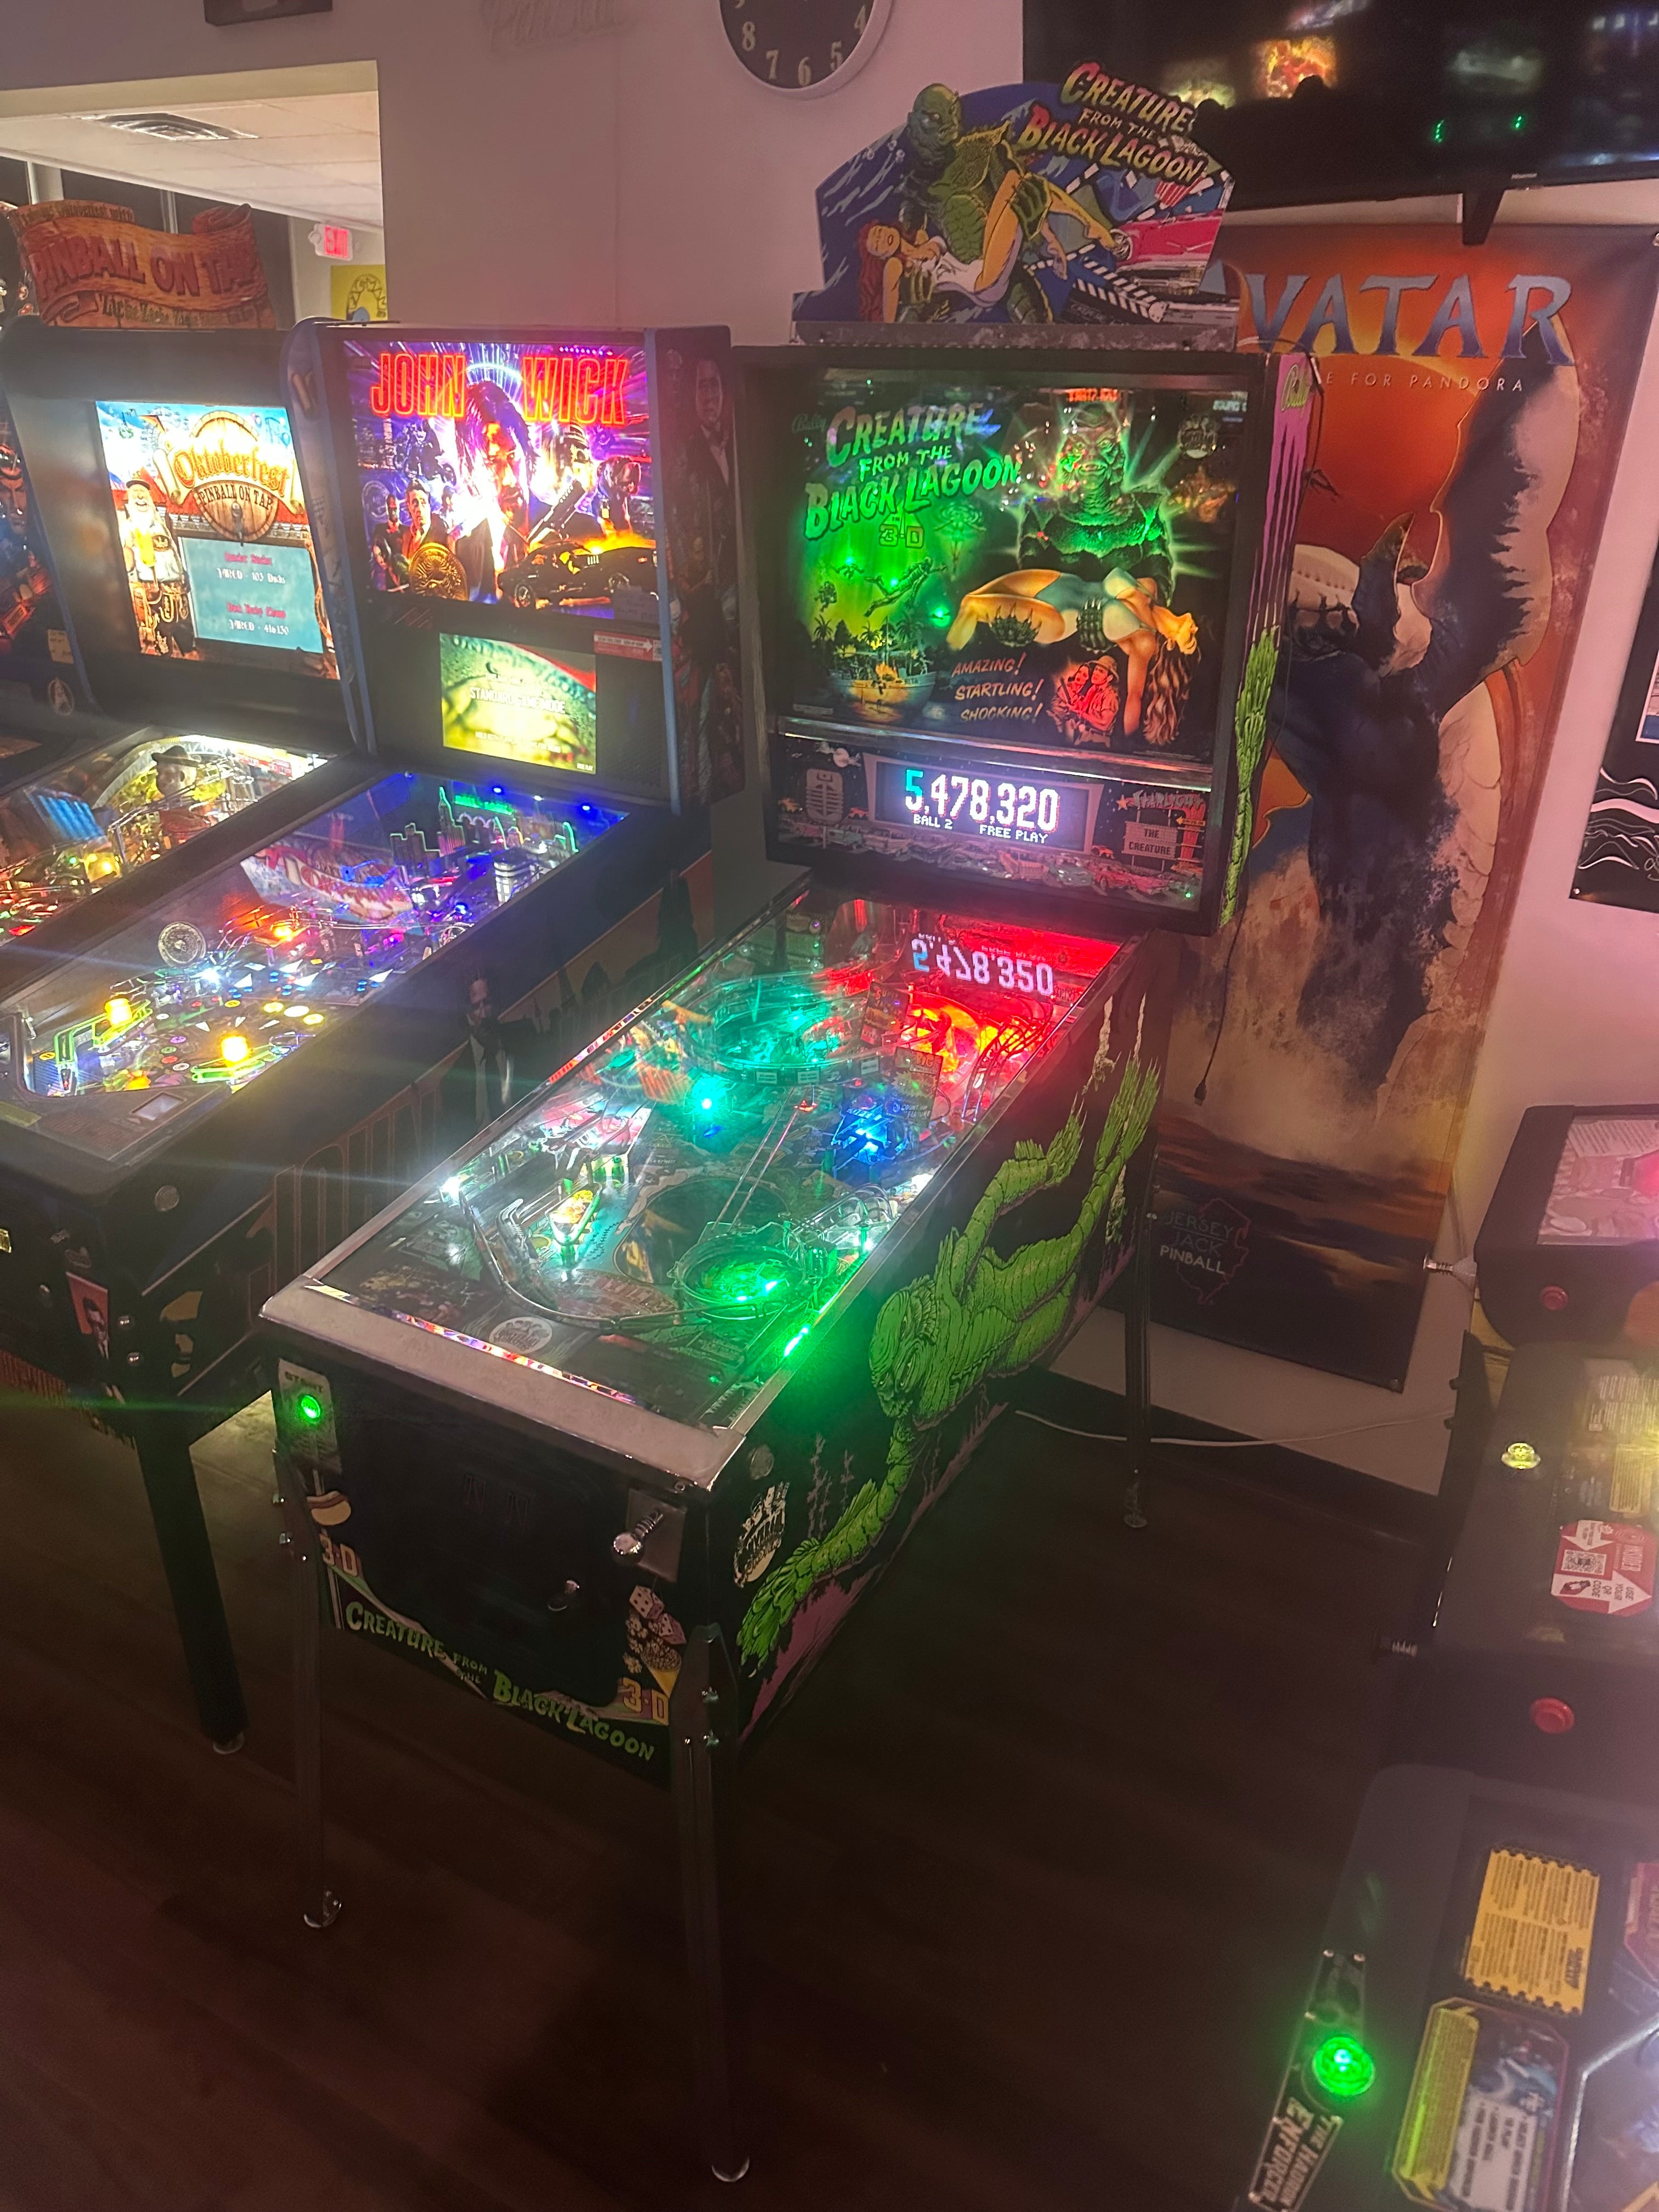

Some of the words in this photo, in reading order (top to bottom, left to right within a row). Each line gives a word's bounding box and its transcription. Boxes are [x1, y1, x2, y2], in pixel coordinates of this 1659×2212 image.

[742, 21, 756, 52] 8
[766, 49, 779, 80] 7
[798, 56, 811, 86] 6
[830, 41, 844, 72] 5
[1060, 61, 1194, 132] CREATURE
[1077, 108, 1123, 129] FROM
[1127, 122, 1156, 138] THE
[1012, 104, 1108, 160] BLACK
[1099, 132, 1205, 182] LAGOON
[30, 235, 146, 300] PINBALL
[150, 246, 201, 297] ON
[370, 352, 467, 419] JOHN
[521, 355, 629, 426] WICK
[1351, 373, 1392, 387] FOR
[1410, 375, 1524, 392] PANDORA
[826, 402, 986, 467] CREATURE
[173, 439, 290, 498] Oktoberfest
[859, 452, 909, 482] FROM
[916, 445, 952, 466] THE
[198, 483, 237, 506] PINBALL
[239, 485, 251, 501] ON
[253, 490, 275, 510] TAP
[804, 473, 900, 540] BLACK
[904, 455, 1022, 515] LAGOON
[879, 524, 925, 549] 3-D
[951, 651, 1027, 678] AMAZING!
[955, 679, 1044, 701] STARTLING!
[960, 703, 1043, 725] SHOCKING!
[905, 769, 1060, 833] 5,478,320
[913, 814, 941, 828] BALL
[944, 819, 953, 830] 2
[979, 825, 1011, 839] FREE
[1015, 830, 1048, 844] PLAY
[1144, 828, 1160, 839] THE
[1128, 842, 1172, 855] CREATURE
[1164, 1211, 1234, 1239] JERSEY
[1160, 1245, 1226, 1274] PINBALL
[1170, 1232, 1223, 1257] JACK
[319, 1533, 360, 1577] 3-D
[1592, 1580, 1602, 1598] CODE
[1602, 1585, 1612, 1595] QR
[1613, 1583, 1624, 1601] YOUR
[1625, 1587, 1634, 1601] USE
[346, 1601, 447, 1658] CREATURE
[453, 1652, 488, 1675] FROM
[458, 1669, 481, 1684] THE
[493, 1669, 564, 1723] BLACK
[566, 1702, 655, 1760] LAGOON
[622, 1677, 669, 1726] 3-D
